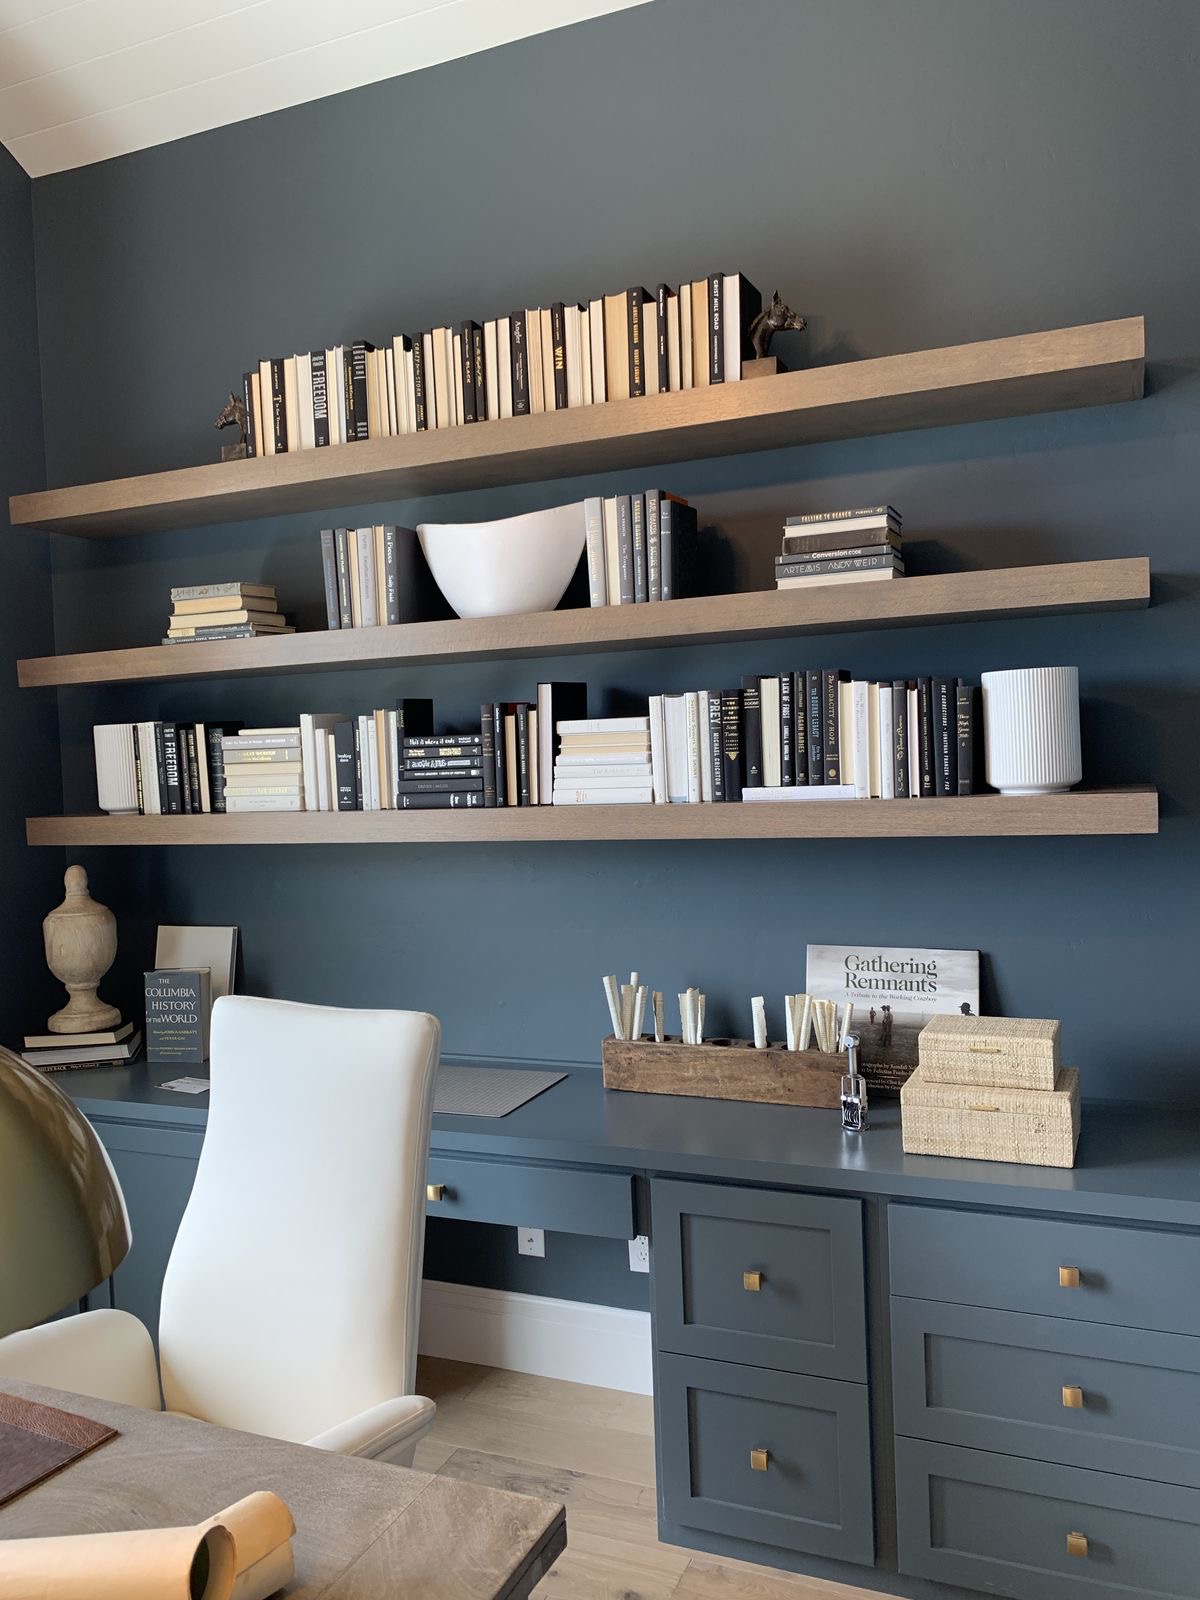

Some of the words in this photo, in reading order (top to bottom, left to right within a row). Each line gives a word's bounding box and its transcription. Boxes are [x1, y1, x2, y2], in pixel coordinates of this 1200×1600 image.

[555, 346, 563, 370] WIN
[274, 394, 282, 402] T
[312, 371, 327, 419] FREEDOM
[802, 514, 822, 522] FALLING
[811, 550, 847, 559] Conversion
[784, 564, 820, 574] ARTEMIS
[828, 561, 852, 570] ANDY
[853, 558, 877, 567] WEIR
[710, 698, 720, 723] PREY
[165, 742, 178, 786] FREEDOM
[845, 954, 938, 979] Gathering
[845, 972, 937, 992] Remnants
[145, 988, 196, 997] COLUMBIA
[152, 1001, 196, 1010] HISTORY
[161, 1014, 197, 1023] WORLD
